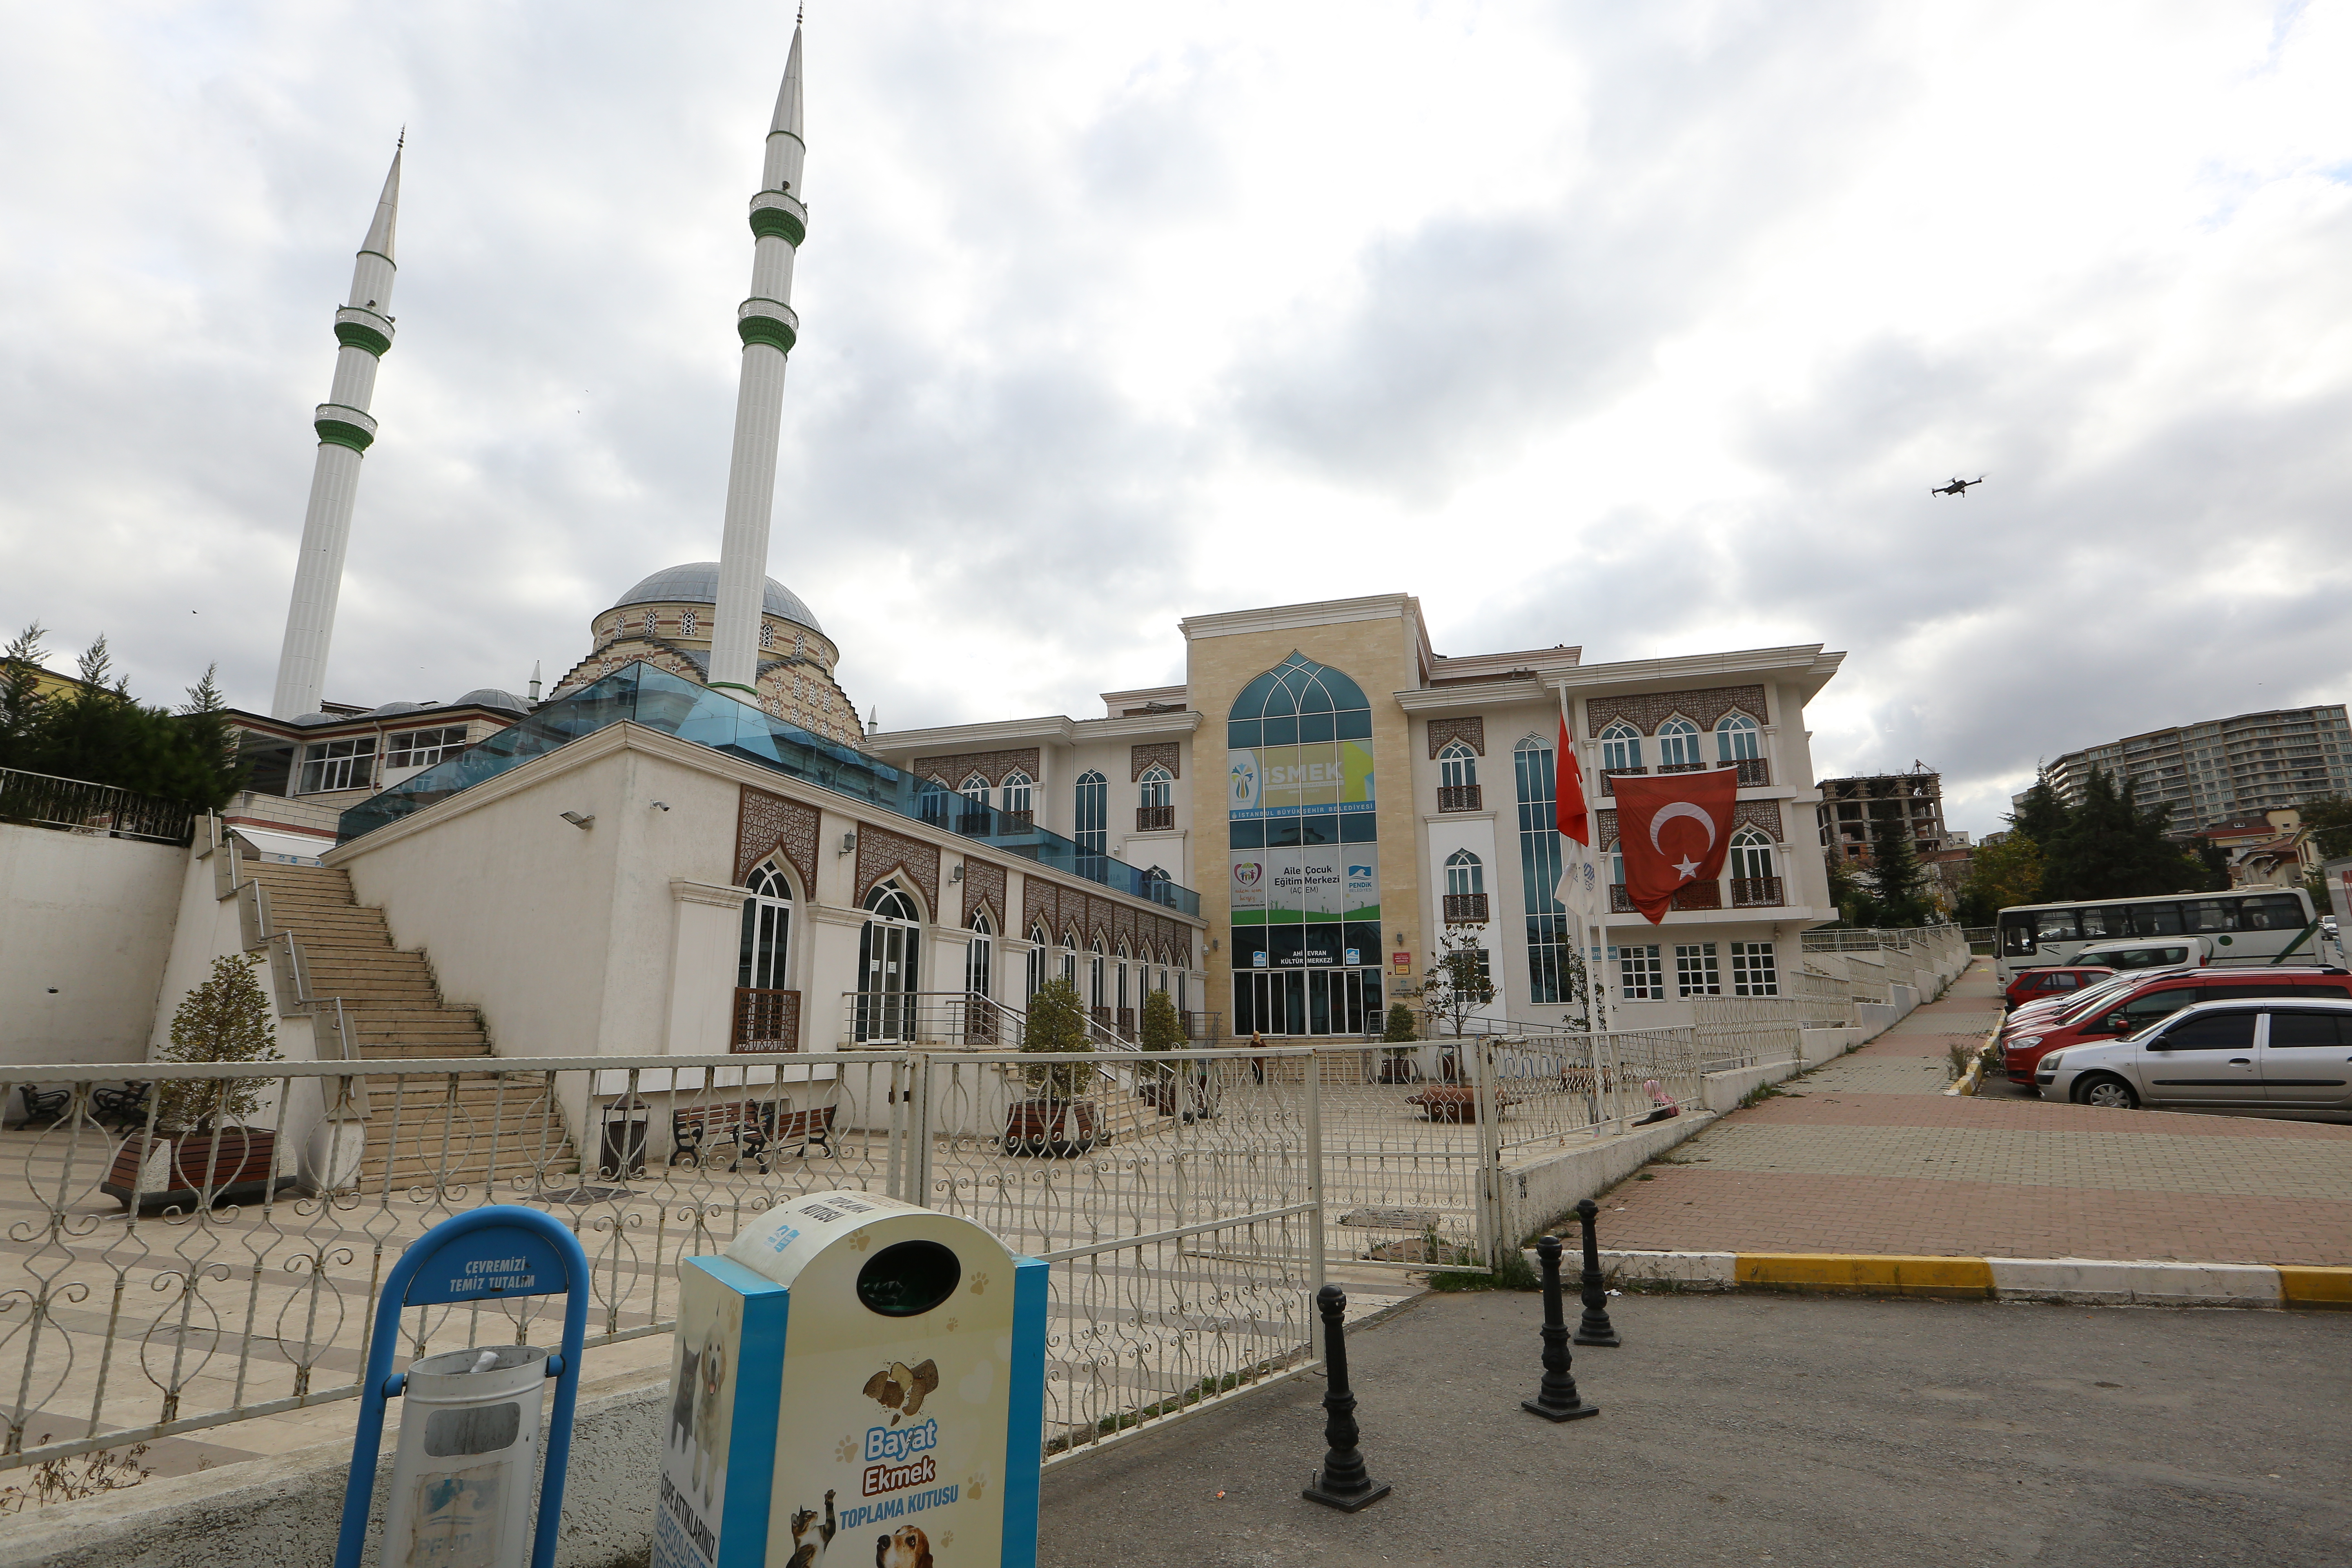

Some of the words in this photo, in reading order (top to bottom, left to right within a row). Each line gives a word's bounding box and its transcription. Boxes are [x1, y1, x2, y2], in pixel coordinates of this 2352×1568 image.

[1277, 807, 1324, 815] BÜYÜKŞEHİR
[1329, 804, 1373, 812] BELEDİYESİ
[1284, 866, 1301, 875] Aile
[1305, 865, 1332, 876] Çocuk
[1275, 877, 1302, 887] Eğitim
[1305, 875, 1340, 884] Merkezi
[798, 1204, 846, 1223] KUTUSU
[823, 1196, 876, 1214] TOPLAMA
[466, 1256, 526, 1276] ÇEVREMİZİ
[450, 1275, 485, 1292] TEMİZ
[866, 1419, 937, 1461] Bayat
[863, 1456, 935, 1496] Ekmek
[661, 1469, 675, 1510] ÇÖPE
[674, 1491, 715, 1564] ATTIKLARINIZ
[840, 1497, 904, 1530] TOPLAMA
[907, 1485, 959, 1514] KUTUSU
